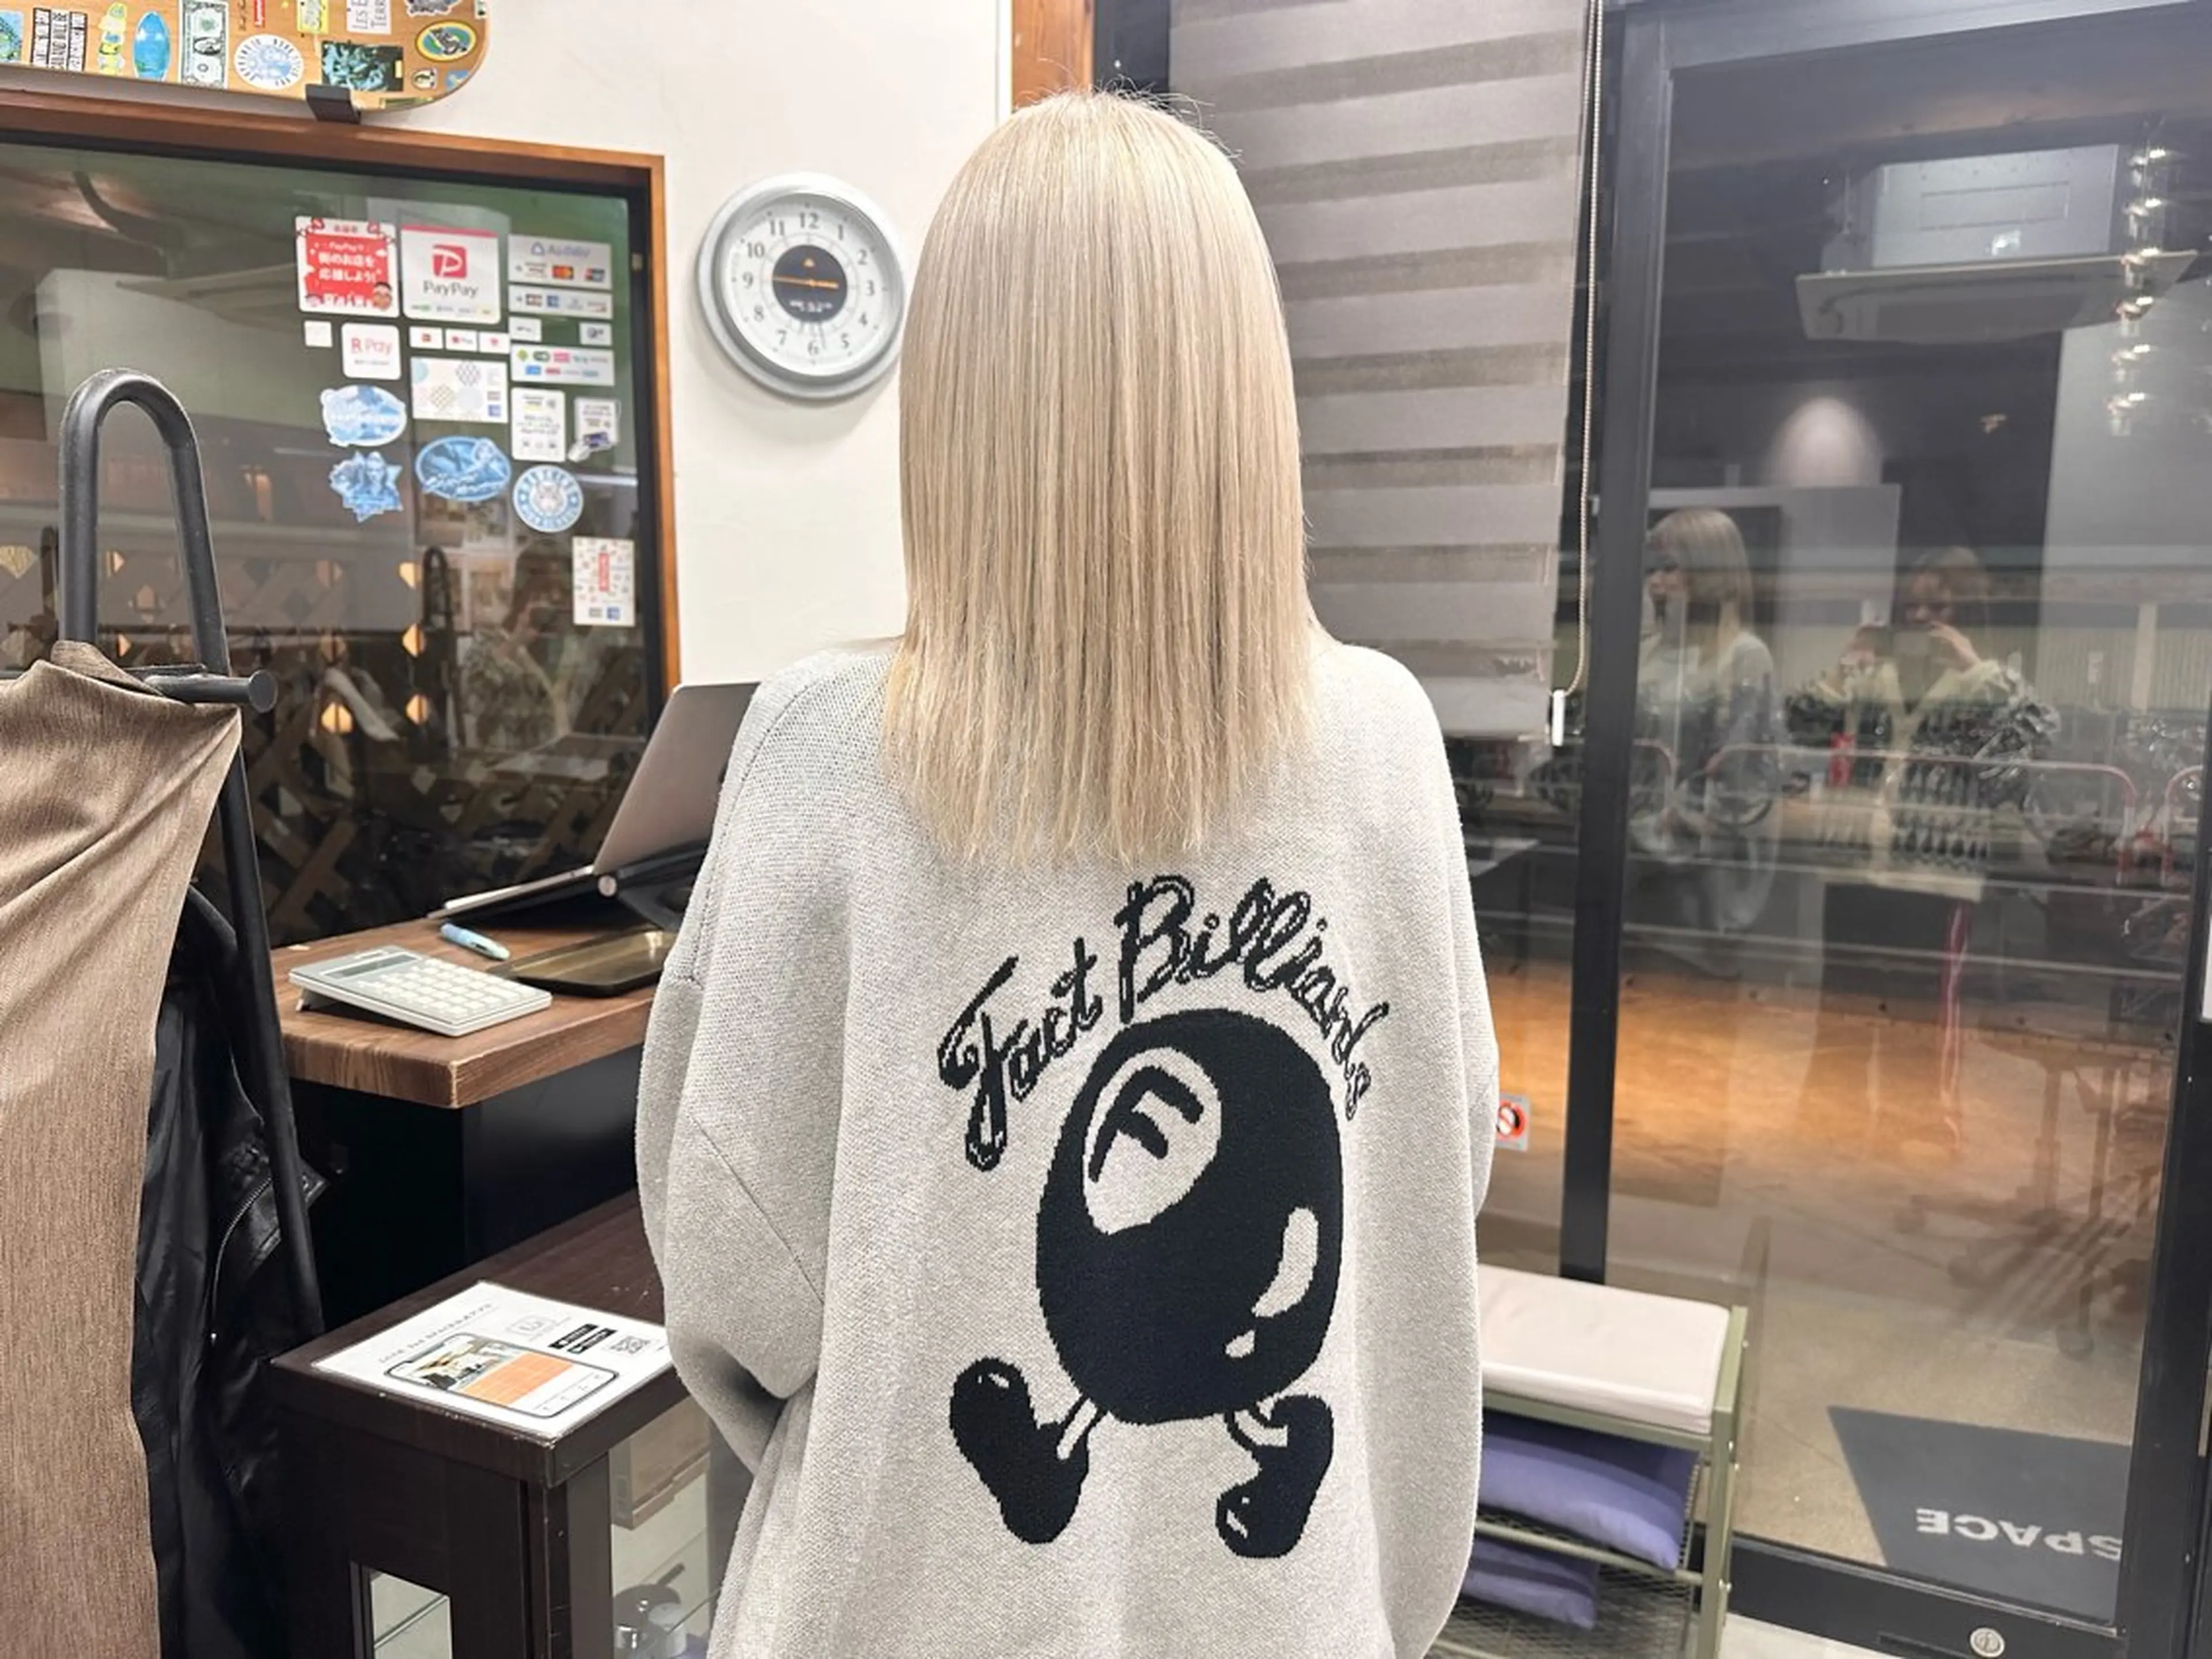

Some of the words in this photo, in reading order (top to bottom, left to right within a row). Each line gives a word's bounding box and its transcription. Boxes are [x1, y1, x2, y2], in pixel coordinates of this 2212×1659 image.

[770, 220, 785, 236] 11
[799, 212, 820, 229] 12
[838, 224, 843, 240] 1
[747, 243, 765, 258] 10
[857, 249, 868, 265] 2
[743, 272, 753, 289] 9
[865, 280, 874, 296] 3
[423, 280, 478, 299] PayPay
[753, 305, 764, 321] 8
[858, 313, 868, 326] 4
[777, 329, 787, 346] 7
[841, 333, 850, 348] 5
[808, 340, 819, 355] 6
[937, 937, 1103, 1171] Fact
[1114, 874, 1389, 1121] Billiards
[1916, 1508, 2122, 1561] SPACE
